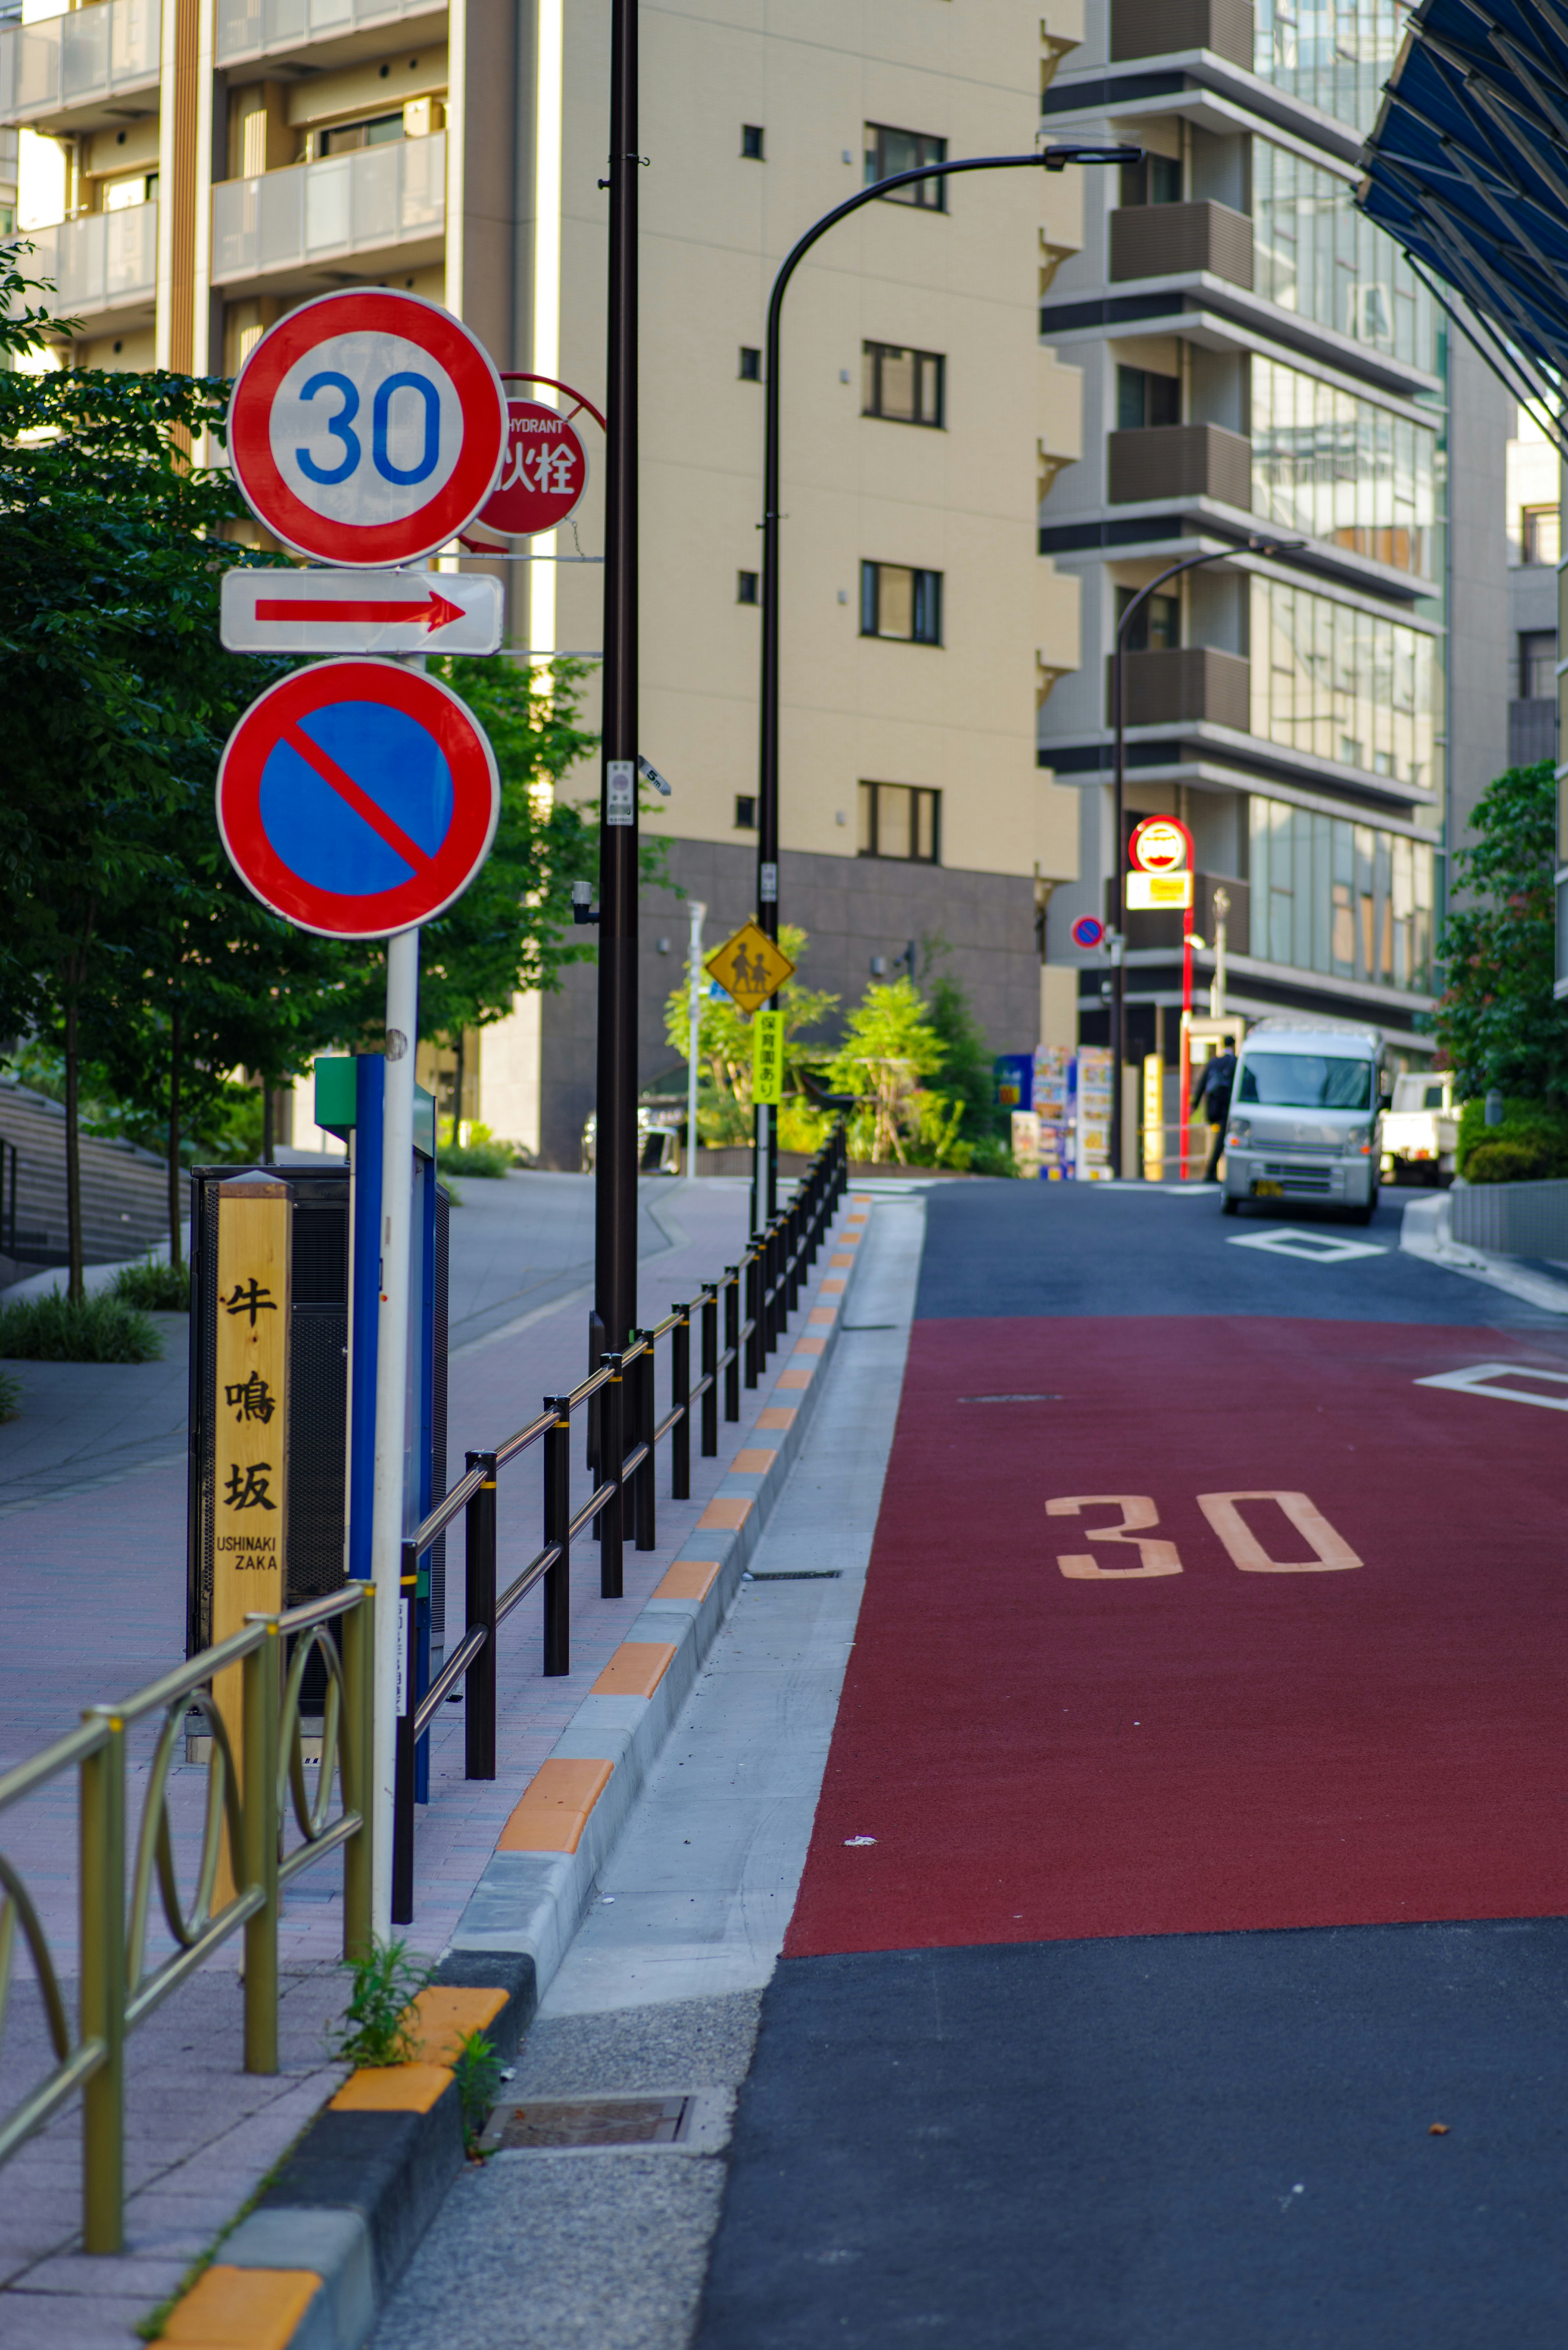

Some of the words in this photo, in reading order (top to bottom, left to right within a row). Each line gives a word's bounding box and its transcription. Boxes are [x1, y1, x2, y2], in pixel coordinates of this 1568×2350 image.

[296, 371, 440, 486] 30
[509, 418, 564, 433] HYDRANT
[494, 442, 577, 494] 火栓
[224, 1278, 277, 1511] 牛鳴坂
[217, 1536, 276, 1551] USHINAKI
[1045, 1491, 1364, 1579] 30
[235, 1556, 277, 1570] ZAKA
